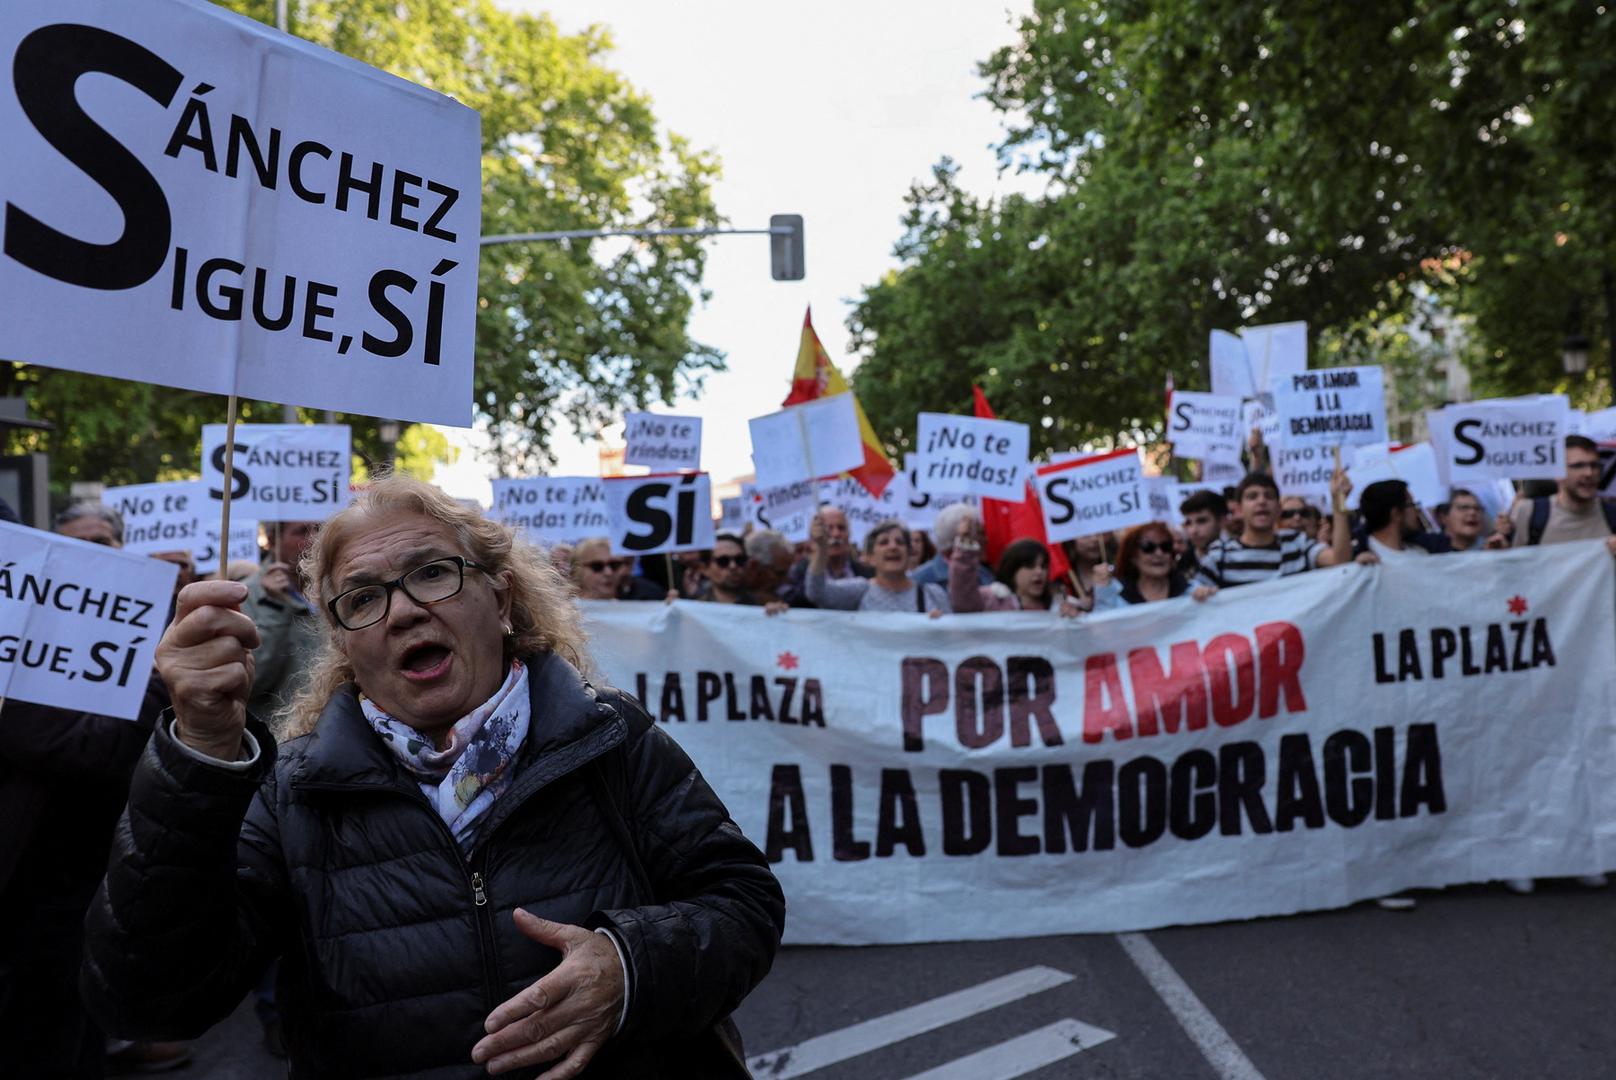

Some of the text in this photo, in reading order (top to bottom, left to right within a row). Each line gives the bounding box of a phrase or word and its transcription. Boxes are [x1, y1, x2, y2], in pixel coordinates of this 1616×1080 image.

[4, 23, 459, 291] SÁNCHEZ
[1293, 371, 1360, 392] POR AMOR
[1316, 393, 1341, 411] A LA
[672, 424, 691, 438] te
[1290, 413, 1373, 436] DEMOCRACIA
[928, 427, 1011, 454] ¡No te
[1454, 419, 1556, 465] SÁNCHEZ
[209, 443, 341, 500] SÁNCHEZ
[928, 458, 1017, 486] rindas!
[164, 493, 188, 513] te
[545, 486, 567, 503] te
[125, 518, 198, 544] indas!
[574, 508, 609, 528] rin
[0, 562, 154, 629] ÁNCHEZ
[1373, 617, 1556, 683] LA PLAZA
[636, 671, 826, 728] LA PLAZA
[901, 621, 1307, 752] POR AMOR
[765, 722, 1447, 864] A LA DEMOCRACIA
